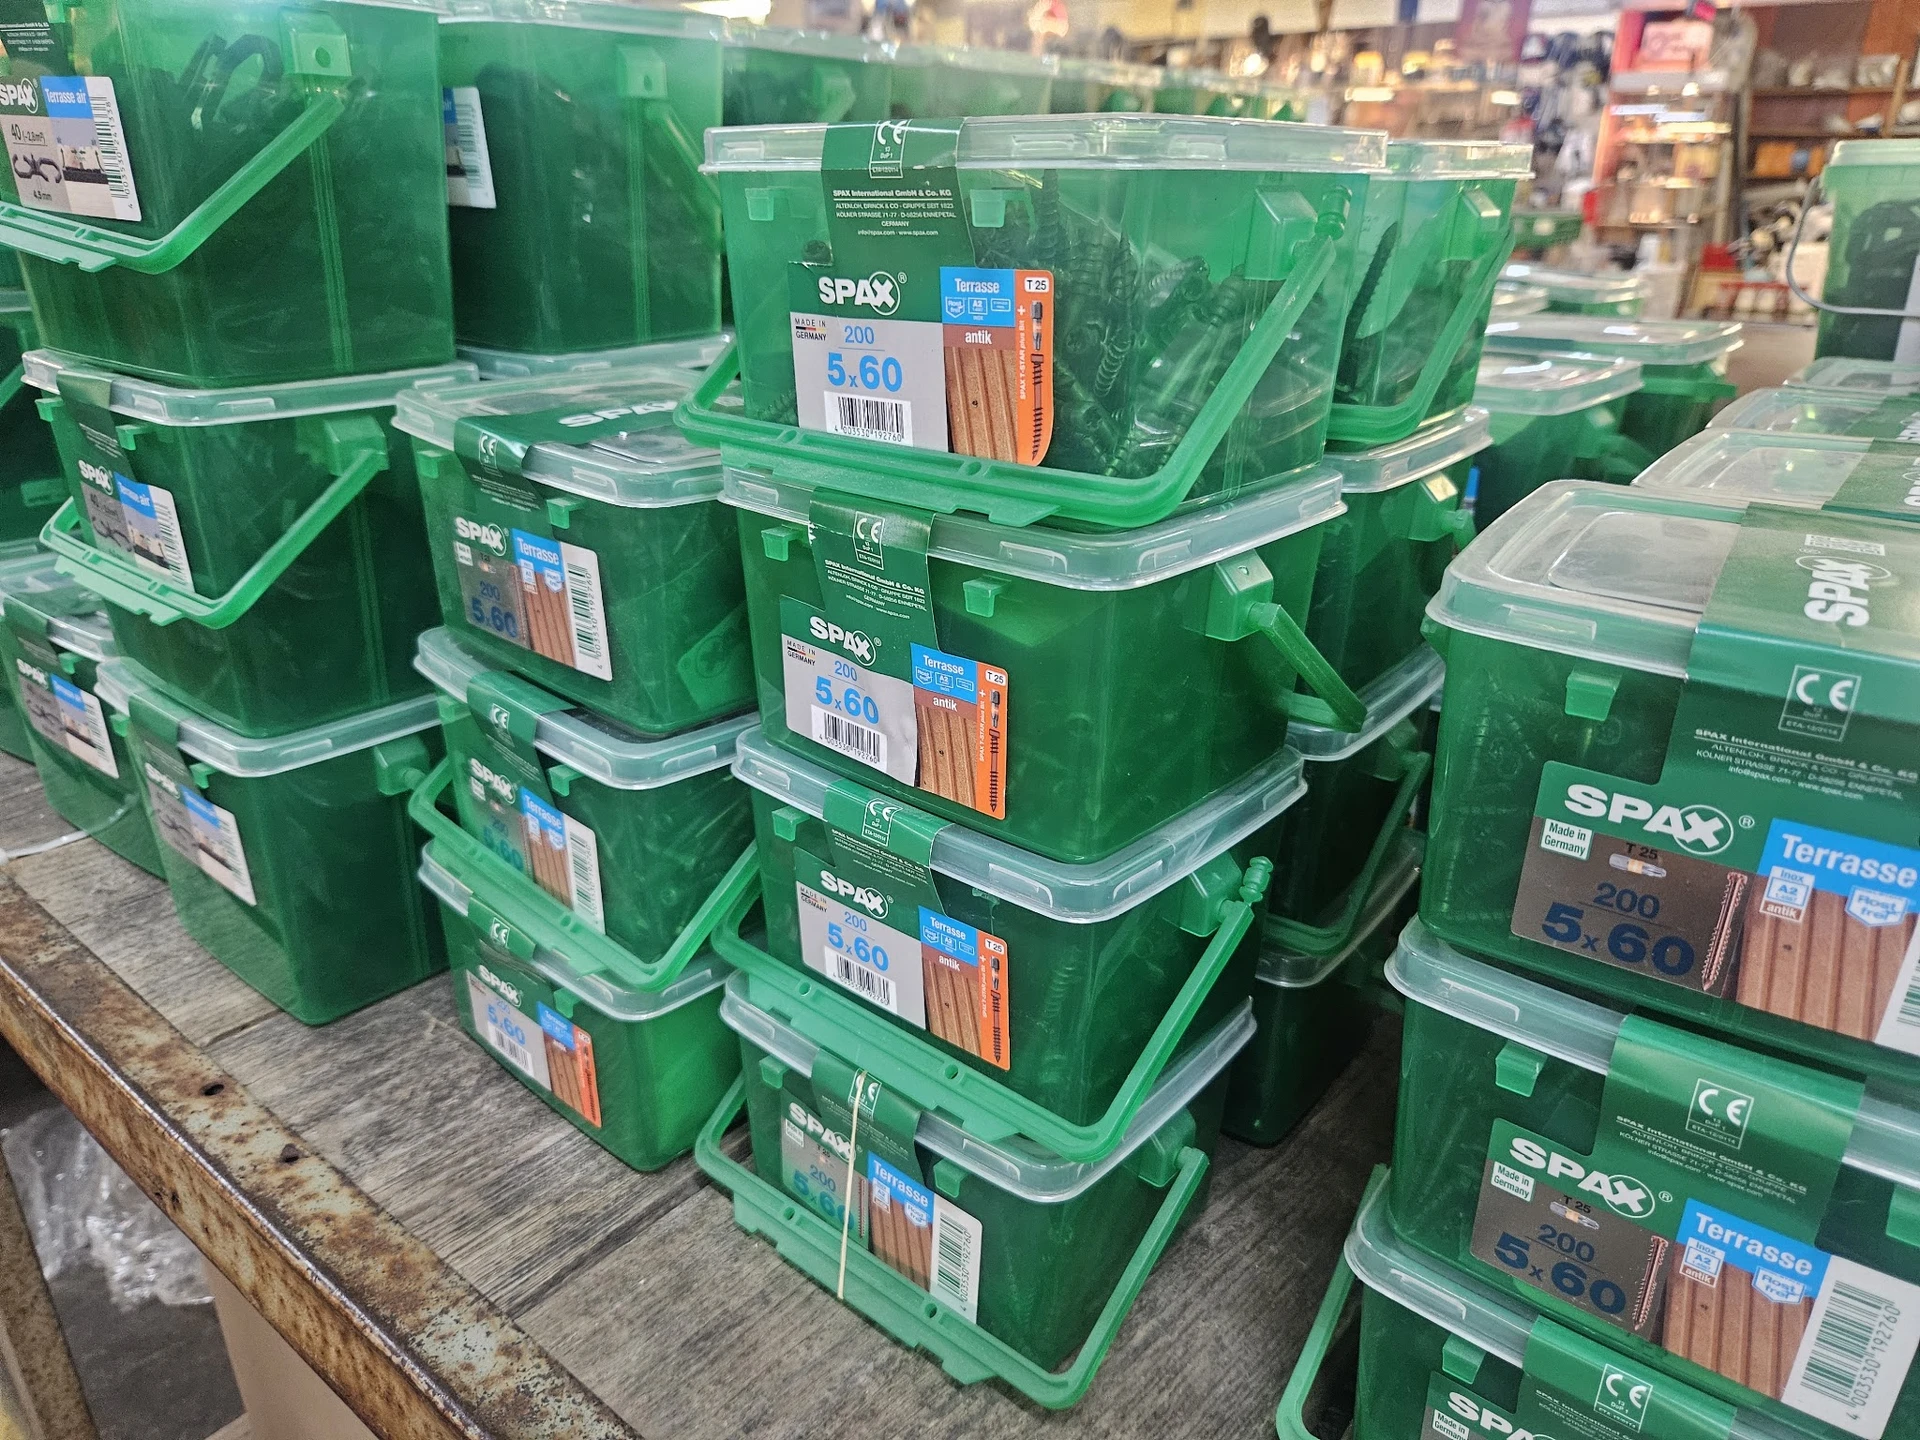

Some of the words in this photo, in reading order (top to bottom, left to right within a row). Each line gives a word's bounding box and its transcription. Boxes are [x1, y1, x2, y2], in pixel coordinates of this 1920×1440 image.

[44, 88, 76, 104] Terrasse
[76, 89, 87, 104] air
[11, 124, 21, 140] 40
[833, 189, 851, 197] SPAX
[851, 189, 895, 197] International
[895, 189, 917, 197] GmbH
[939, 189, 952, 197] KG
[818, 273, 899, 313] SPAX
[954, 278, 1000, 293] Terrasse
[1026, 279, 1034, 290] T
[1035, 280, 1047, 290] 25
[973, 300, 983, 308] A2
[795, 317, 816, 328] MADE
[818, 320, 827, 328] IN
[795, 330, 827, 342] GERMANY
[844, 325, 875, 345] 200
[965, 329, 993, 345] antik
[827, 352, 903, 393] 5x60
[842, 426, 870, 438] 003530
[873, 428, 903, 443] 192760
[78, 460, 112, 494] SPAX
[455, 517, 505, 554] SPAX
[517, 537, 560, 566] Terrasse
[479, 580, 501, 601] 200
[1799, 557, 1880, 627] SPAX
[471, 598, 518, 638] 5x60
[787, 639, 806, 653] MADE
[808, 648, 816, 656] IN
[810, 616, 874, 663] SPAX
[787, 650, 816, 667] GERMANY
[923, 654, 965, 676] Terrasse
[834, 660, 858, 682] 200
[987, 671, 993, 680] T
[994, 673, 1004, 684] 25
[815, 675, 880, 724] 5x60
[933, 697, 957, 712] antik
[1695, 728, 1727, 741] SPAX
[1731, 735, 1812, 759] International
[1815, 752, 1855, 767] GmbH
[1696, 750, 1733, 763] KÖLNER
[1734, 757, 1776, 772] STRASSE
[1777, 767, 1801, 777] 71-77
[1728, 765, 1791, 785] info@spax.com
[470, 758, 515, 802] SPAX
[524, 794, 562, 830] Terrasse
[1564, 784, 1729, 852] SPAX
[1548, 821, 1576, 839] Made
[1577, 830, 1587, 841] in
[1544, 834, 1586, 857] Germany
[1626, 842, 1637, 854] T
[1639, 846, 1659, 860] 25
[1782, 833, 1918, 889] Terrasse
[800, 886, 817, 898] MADE
[821, 871, 886, 916] SPAX
[1593, 881, 1661, 920] 200
[1777, 883, 1798, 896] A2
[800, 895, 827, 913] GERMANY
[1766, 902, 1798, 920] antik
[1857, 894, 1897, 909] Rost
[844, 911, 868, 932] 200
[930, 916, 966, 941] Terrasse
[828, 921, 890, 972] 5x60
[986, 940, 992, 949] T
[993, 942, 1003, 953] 25
[1541, 902, 1696, 976] 5x60
[939, 954, 961, 972] antik
[478, 964, 520, 1007] SPAX
[487, 1005, 526, 1046] 5x60
[789, 1102, 854, 1161] SPAX
[1616, 1115, 1644, 1130] SPAX
[1647, 1127, 1717, 1157] International
[1719, 1155, 1753, 1171] GmbH
[1619, 1132, 1650, 1148] KÖLNER
[1651, 1143, 1688, 1162] STRASSE
[1689, 1158, 1710, 1171] 71-77
[1647, 1149, 1701, 1173] info@spax.com
[809, 1164, 837, 1193] 200
[874, 1160, 929, 1208] Terrasse
[1497, 1164, 1519, 1181] Made
[1520, 1173, 1530, 1187] in
[1510, 1138, 1651, 1215] SPAX
[1493, 1176, 1530, 1199] Germany
[1563, 1194, 1572, 1205] T
[1574, 1200, 1591, 1214] 25
[963, 1229, 973, 1266] 192760
[1538, 1223, 1596, 1263] 200
[1695, 1211, 1813, 1276] Terrasse
[1693, 1252, 1711, 1266] A2
[1494, 1231, 1627, 1315] 5x60
[1684, 1267, 1713, 1285] antik
[1760, 1273, 1797, 1294] Rost
[959, 1267, 970, 1303] 003530
[1871, 1303, 1901, 1354] 192760
[1851, 1358, 1882, 1408] 003530
[1436, 1412, 1458, 1432] Made
[1457, 1424, 1466, 1435] in
[1846, 1411, 1861, 1421] 4
